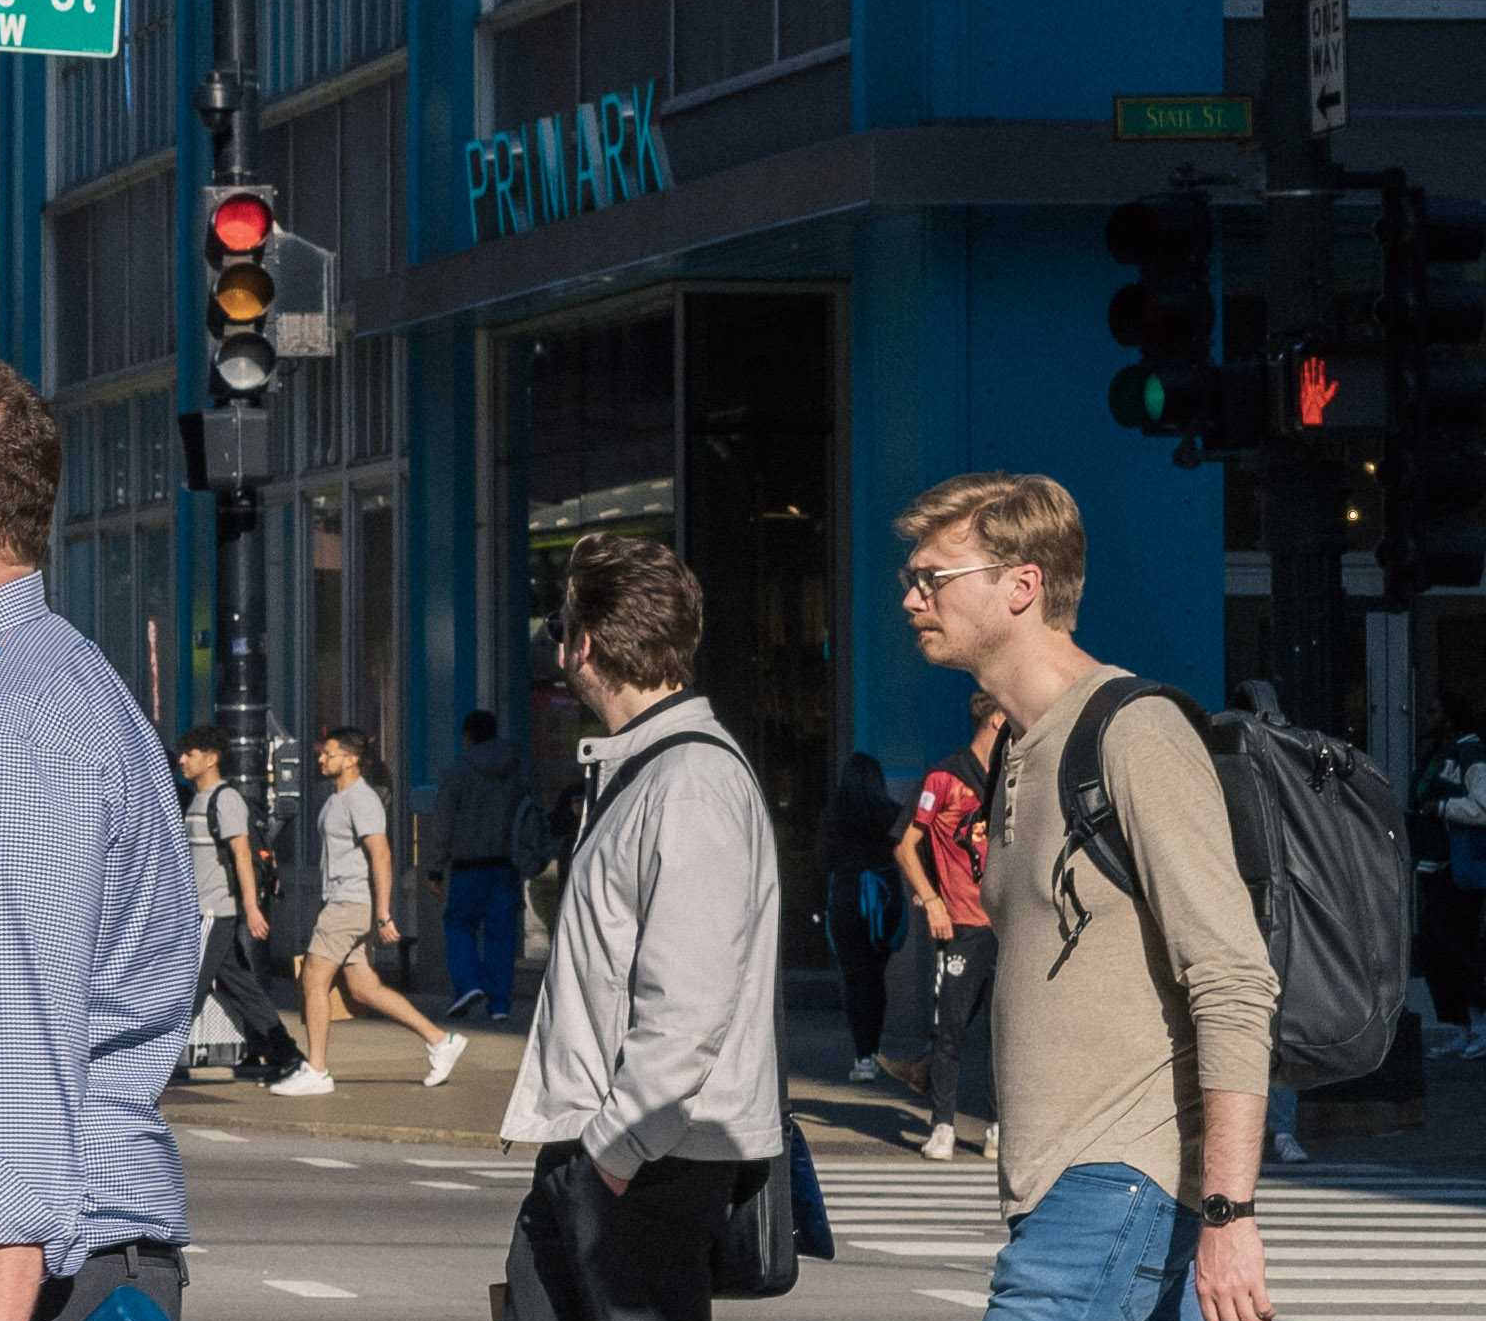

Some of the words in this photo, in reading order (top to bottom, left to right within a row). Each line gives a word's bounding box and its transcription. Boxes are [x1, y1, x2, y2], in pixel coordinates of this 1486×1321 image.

[1311, 0, 1340, 37] ONE
[1312, 40, 1342, 78] WAY
[465, 78, 663, 246] PRIMARK
